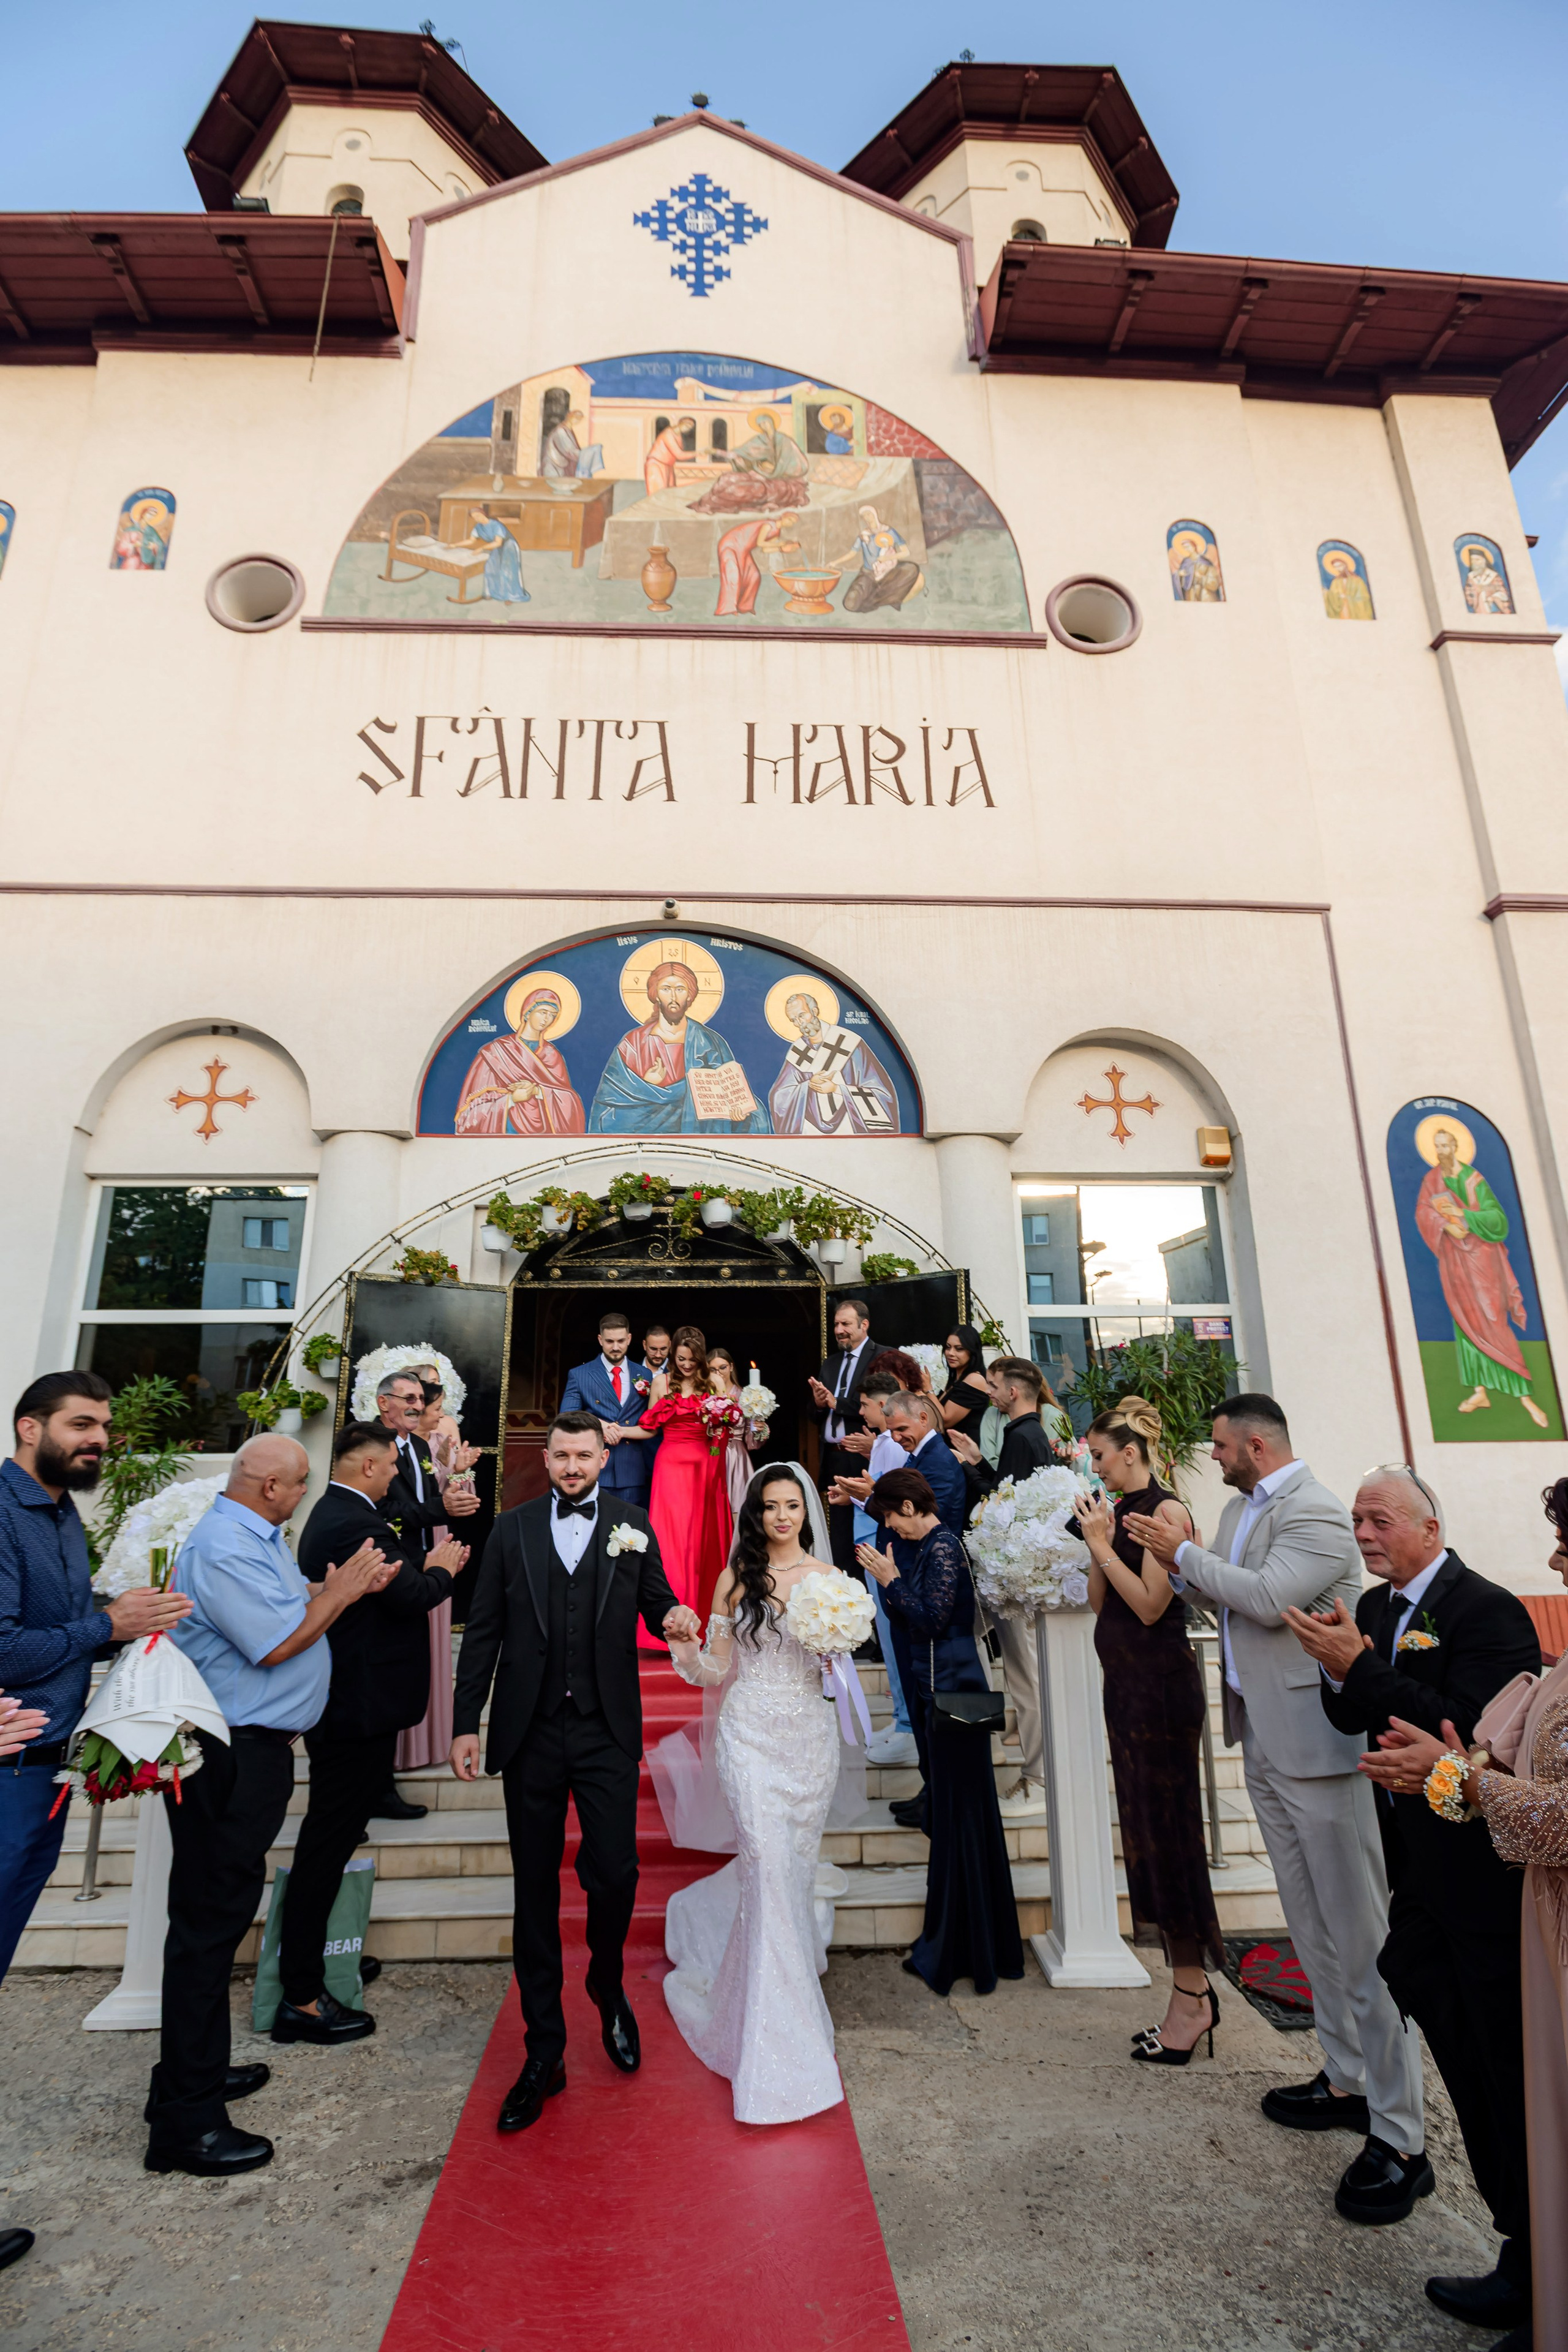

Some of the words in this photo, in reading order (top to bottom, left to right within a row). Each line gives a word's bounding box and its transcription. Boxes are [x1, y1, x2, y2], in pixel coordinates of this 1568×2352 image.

[357, 706, 677, 802] SFÂNTA
[113, 1690, 123, 1711] With
[126, 1695, 135, 1708] the
[323, 1937, 363, 1956] BEAR
